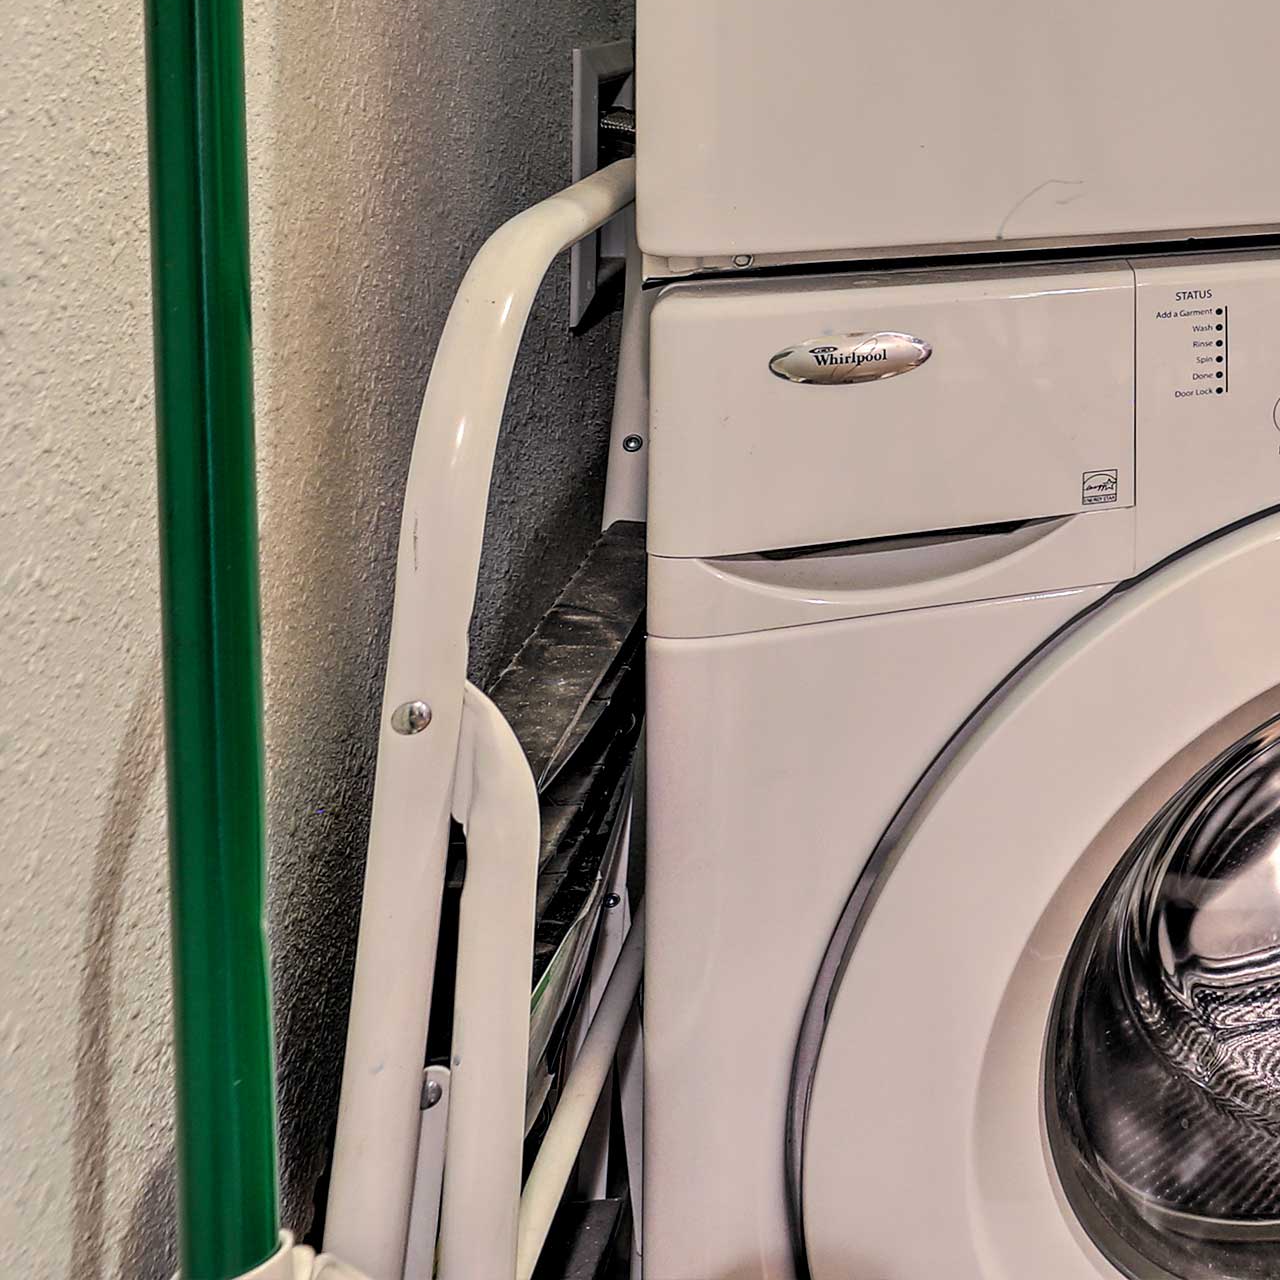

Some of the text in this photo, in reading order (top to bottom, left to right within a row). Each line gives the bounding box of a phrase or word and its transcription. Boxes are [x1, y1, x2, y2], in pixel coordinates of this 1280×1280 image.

[1175, 289, 1213, 301] STATUS
[1156, 311, 1171, 319] Add
[1179, 308, 1213, 318] Garment
[1192, 324, 1213, 332] Wash
[1192, 340, 1213, 348] Rinse
[814, 349, 888, 366] Whirlpool
[1196, 356, 1213, 365] Spin
[1192, 373, 1213, 381] Done
[1175, 387, 1213, 398] Door Lock
